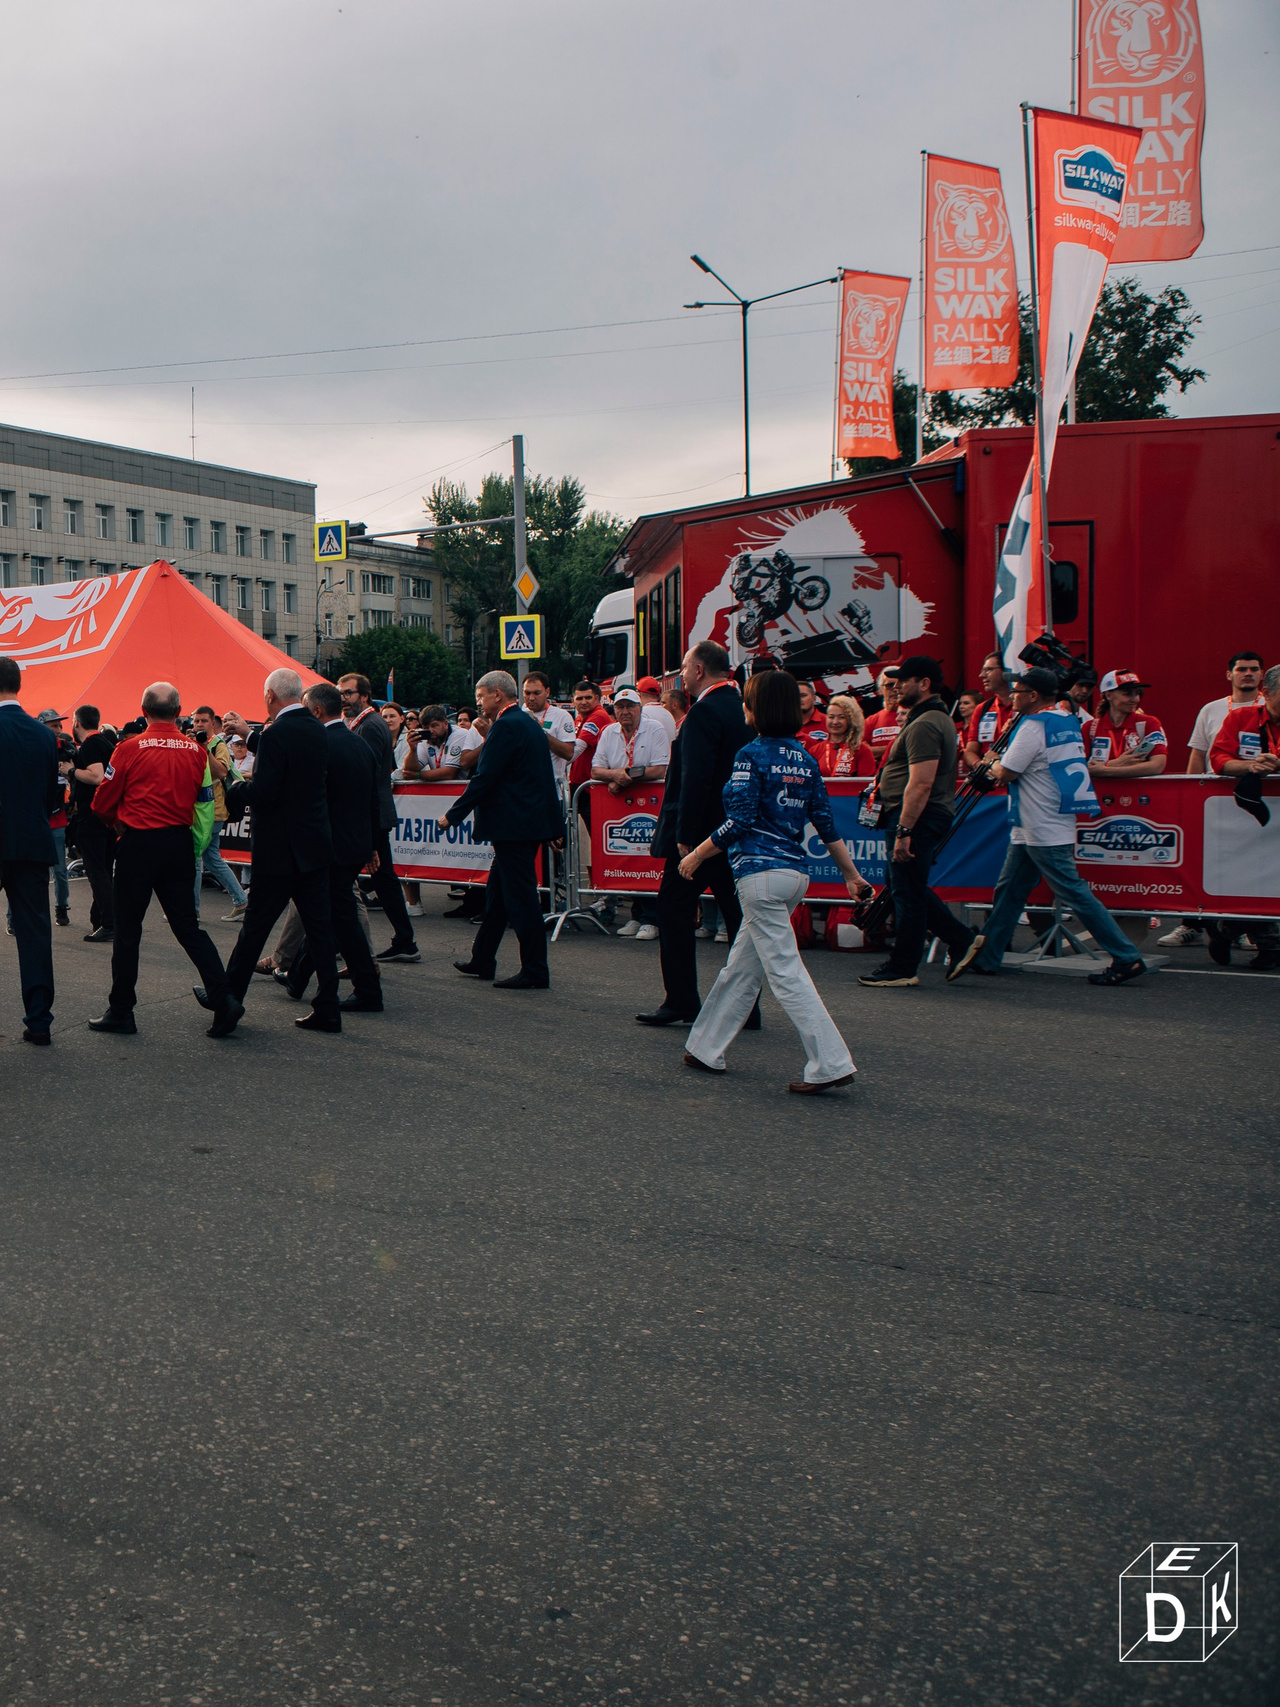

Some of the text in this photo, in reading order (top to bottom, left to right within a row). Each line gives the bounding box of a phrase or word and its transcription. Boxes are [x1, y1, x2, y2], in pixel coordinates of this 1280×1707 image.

[1088, 91, 1195, 127] SILK
[1134, 128, 1196, 164] AY
[1064, 163, 1124, 190] SILK WAY
[1128, 168, 1193, 196] LLY
[1119, 200, 1192, 229] 绸之路
[933, 267, 1009, 293] SILK
[934, 294, 1010, 320] WAY
[933, 323, 1010, 343] RALLY
[933, 346, 1010, 367] 丝绸之路
[842, 404, 890, 422] RALL
[785, 749, 804, 762] VTB
[737, 762, 752, 770] VTB
[771, 765, 812, 777] KAMAZ
[1064, 762, 1098, 801] 2
[394, 817, 495, 847] ГАЗПРОМ
[611, 828, 643, 837] SILK
[1109, 824, 1142, 832] 2025
[1081, 832, 1171, 845] SILK WAY
[441, 848, 487, 861] (Акционерное
[603, 869, 665, 880] #silkwayrally2
[1088, 881, 1184, 896] lkwayrally2025
